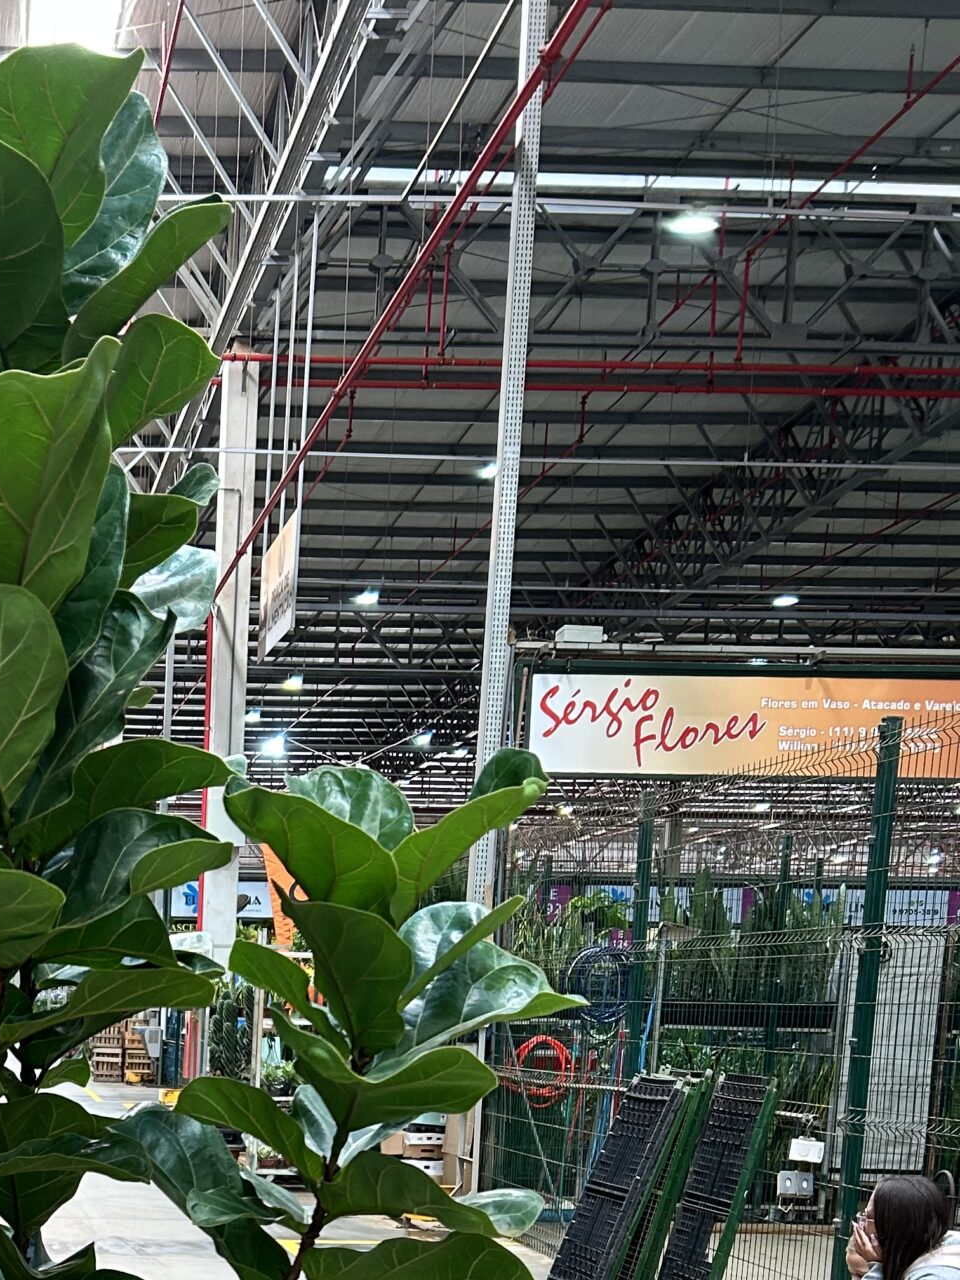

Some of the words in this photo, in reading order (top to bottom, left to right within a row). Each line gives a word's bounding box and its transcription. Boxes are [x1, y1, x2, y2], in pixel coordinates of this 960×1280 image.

[540, 678, 660, 738] Sérgio
[760, 699, 797, 709] Flores
[801, 701, 818, 709] em
[823, 699, 850, 709] Vaso
[862, 699, 910, 710] Atacado
[914, 702, 921, 711] e
[633, 706, 766, 768] Flores
[779, 726, 816, 738] Sérgio
[829, 727, 854, 736] (11)
